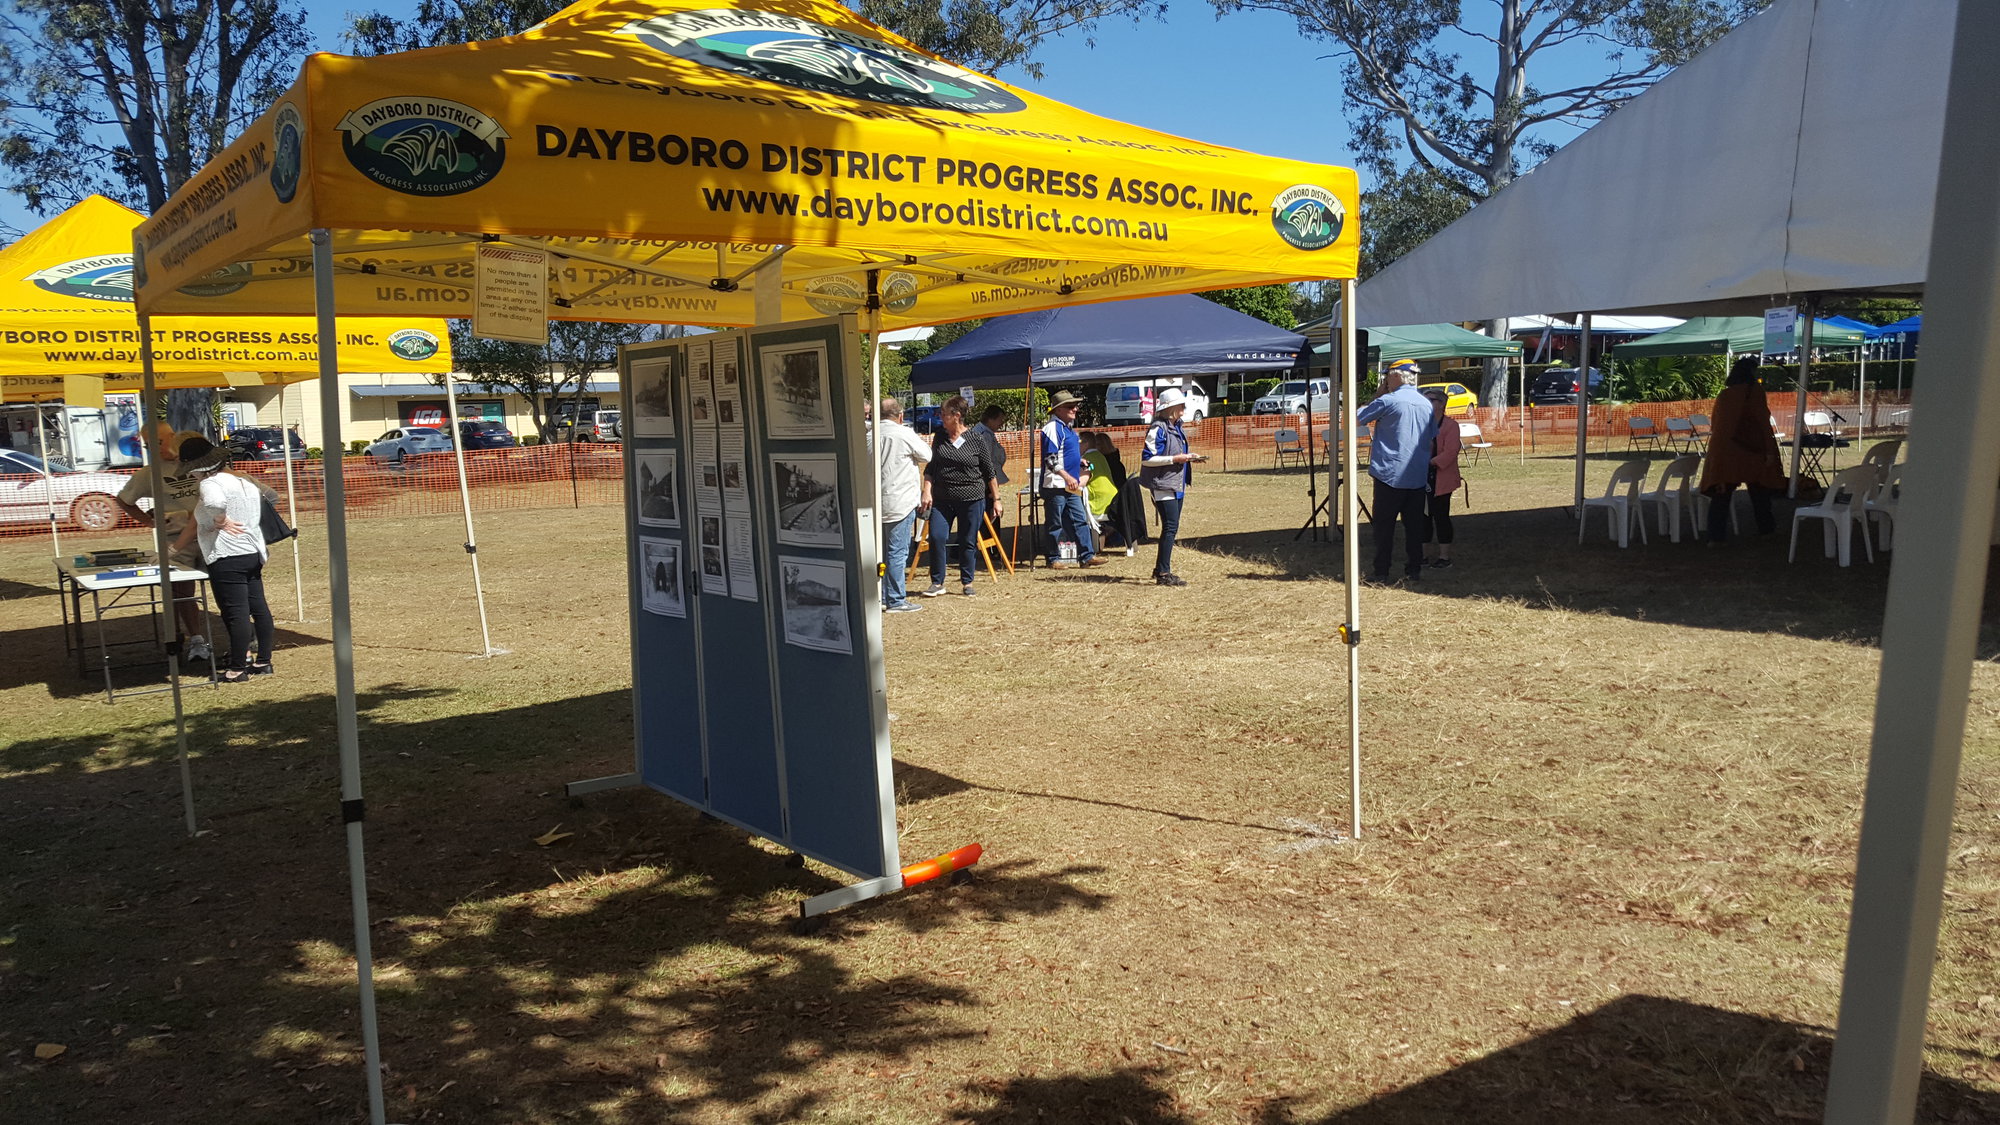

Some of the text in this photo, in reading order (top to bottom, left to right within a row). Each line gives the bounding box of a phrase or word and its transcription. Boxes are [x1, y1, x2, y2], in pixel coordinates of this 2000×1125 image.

[673, 14, 938, 66] DAYBORO DISTRICT
[733, 66, 857, 96] PROGRESS
[361, 102, 484, 131] DAYBORO DISTRICT
[587, 76, 775, 107] Dayboro
[922, 116, 1072, 142] Progress
[1079, 135, 1173, 153] Assoc.
[1175, 146, 1227, 158] Inc.
[368, 167, 489, 192] PROGRESS ASSOCIATION INC
[535, 124, 1259, 217] DAYBORO DISTRICT PROGRESS ASSOC. INC.
[1282, 188, 1335, 207] DAYBORO DISTRICT
[702, 187, 1168, 242] www.dayborodistrict.com.au
[1282, 231, 1301, 246] PROGRESS
[1302, 240, 1328, 248] ASSOCIATION
[494, 279, 517, 287] people
[517, 270, 531, 278] than
[486, 286, 516, 294] permitted
[510, 313, 533, 322] display
[172, 331, 272, 343] PROGRESS
[347, 334, 379, 346] INC.
